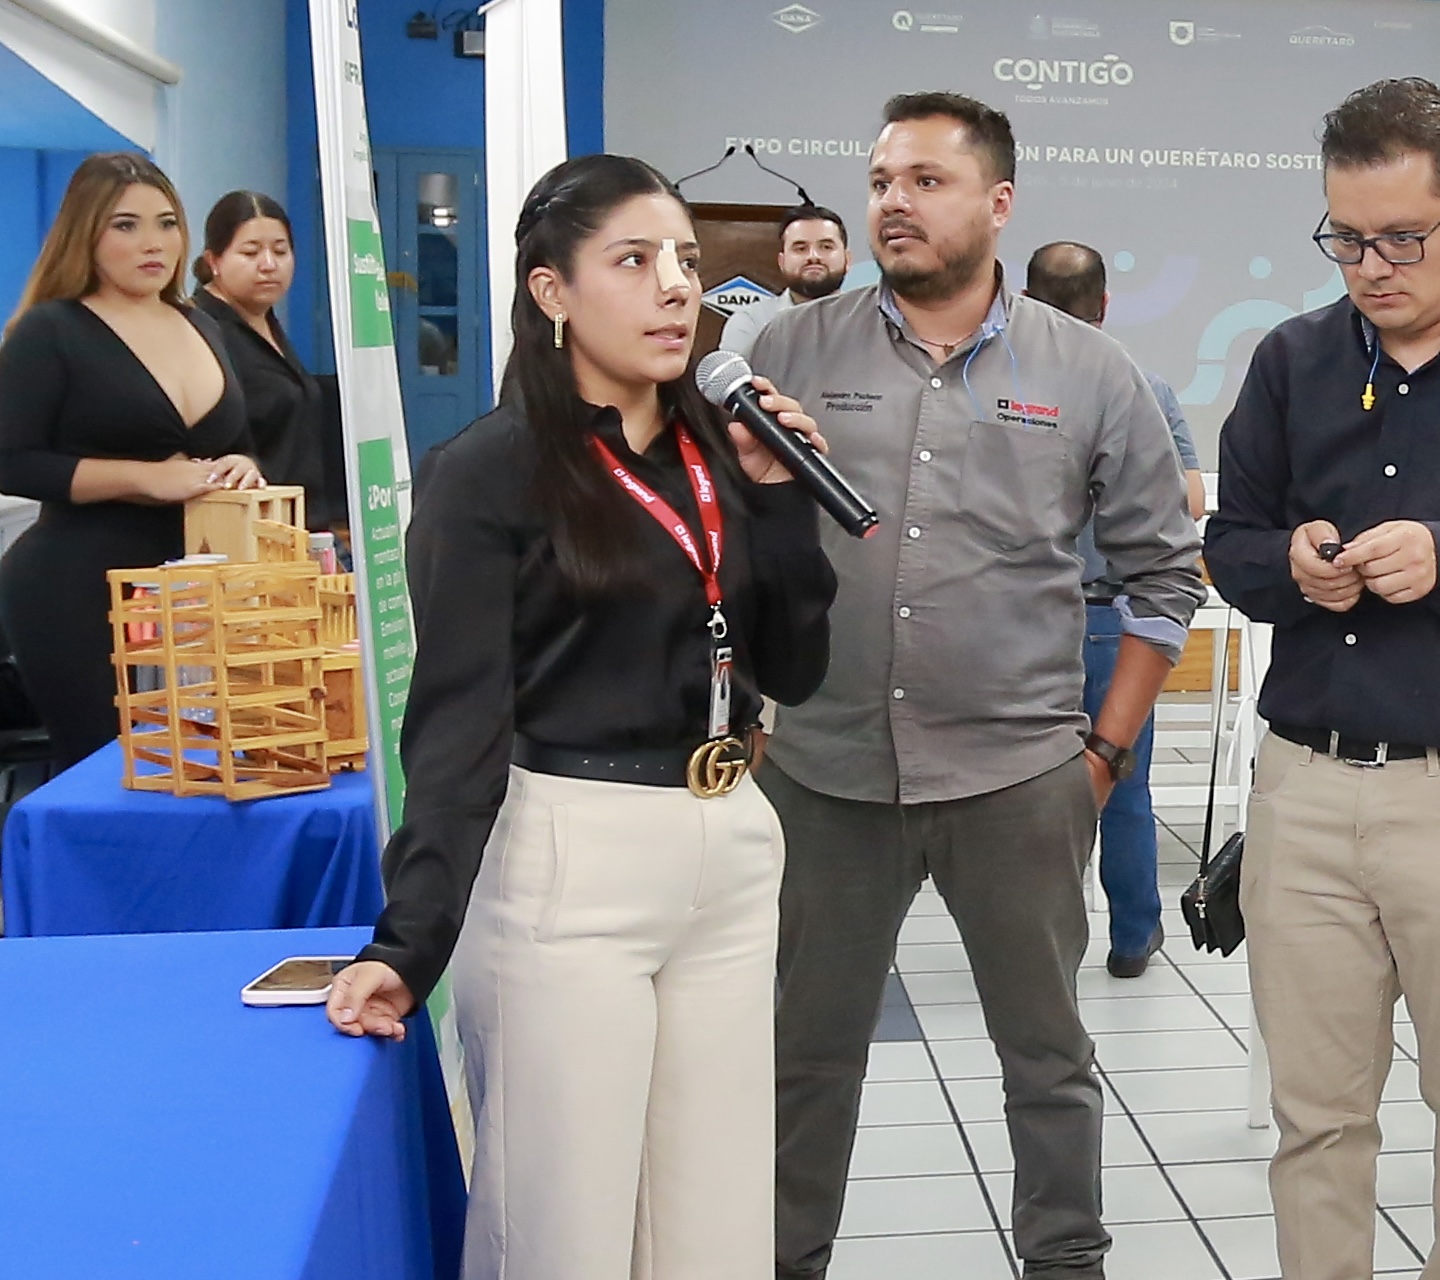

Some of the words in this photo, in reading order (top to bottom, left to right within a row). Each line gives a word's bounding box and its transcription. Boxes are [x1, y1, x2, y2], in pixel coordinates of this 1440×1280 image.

[992, 54, 1134, 89] CONTIGO
[1013, 141, 1040, 162] ÓN
[1046, 145, 1100, 164] PARA
[1105, 148, 1134, 165] UN
[1139, 147, 1261, 169] QUERÉTARO
[1265, 153, 1325, 171] SOSTE
[717, 295, 761, 306] DANA
[1009, 400, 1060, 418] legrand
[621, 473, 656, 504] legrand
